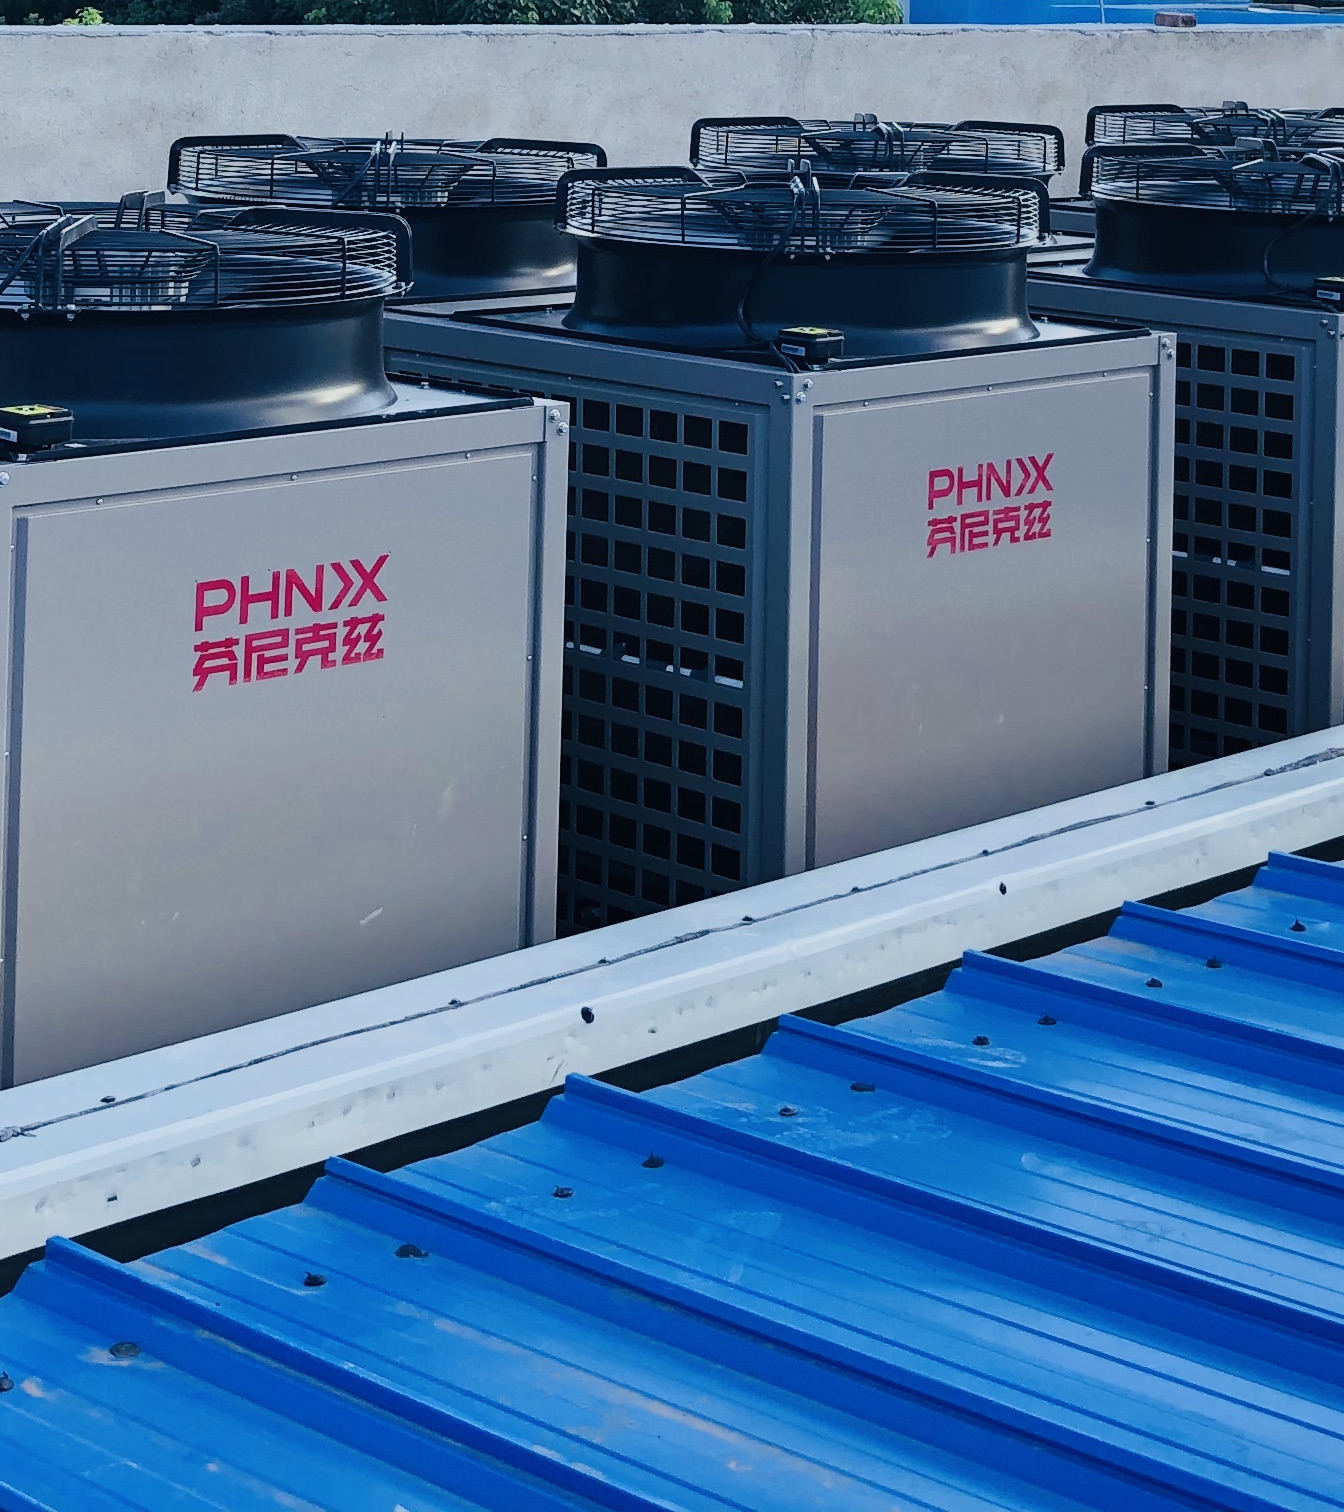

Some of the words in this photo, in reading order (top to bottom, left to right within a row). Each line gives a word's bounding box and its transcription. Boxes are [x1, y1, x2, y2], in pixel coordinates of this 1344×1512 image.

[926, 500, 1053, 559] 芬尼克兹
[191, 612, 386, 693] 芬尼克兹
